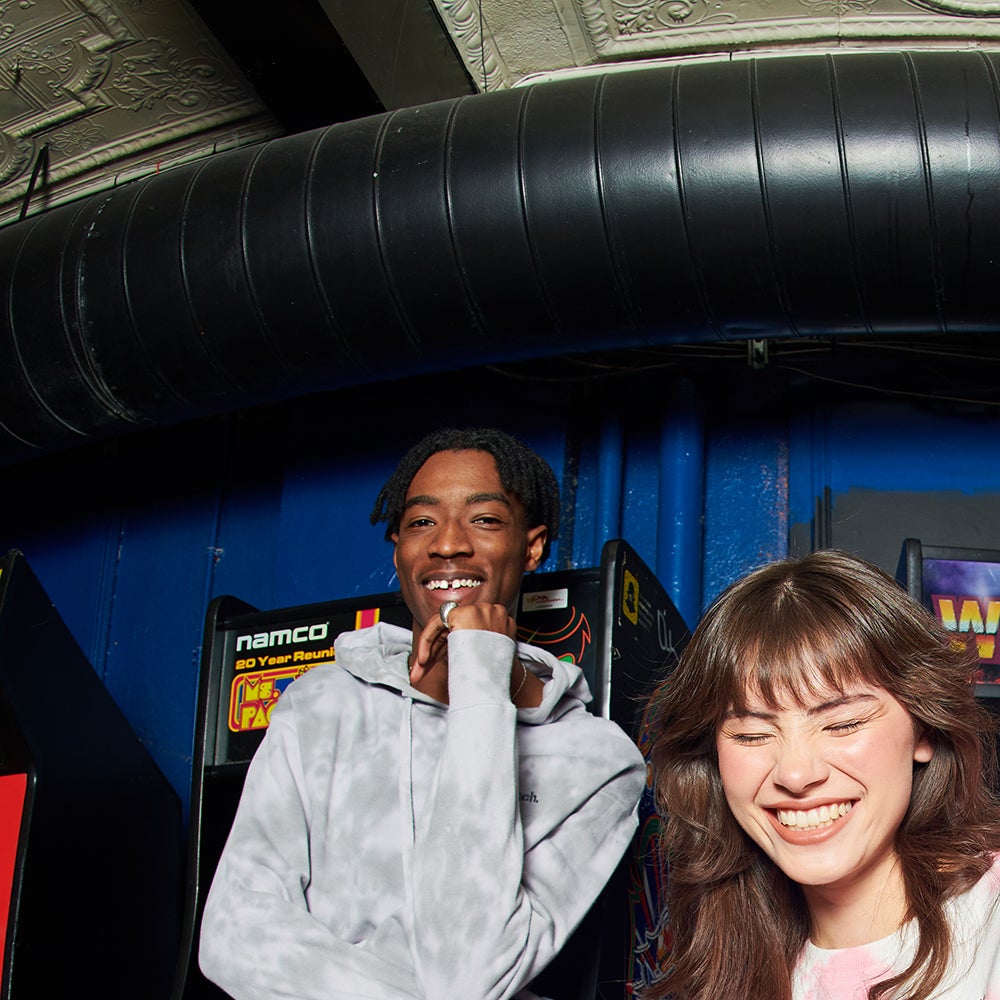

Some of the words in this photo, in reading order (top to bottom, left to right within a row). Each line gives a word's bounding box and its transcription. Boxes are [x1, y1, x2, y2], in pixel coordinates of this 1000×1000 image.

[236, 623, 329, 652] namco
[235, 658, 256, 670] 20
[257, 654, 292, 667] Year
[293, 646, 336, 663] Reuni
[519, 791, 539, 803] ch.
